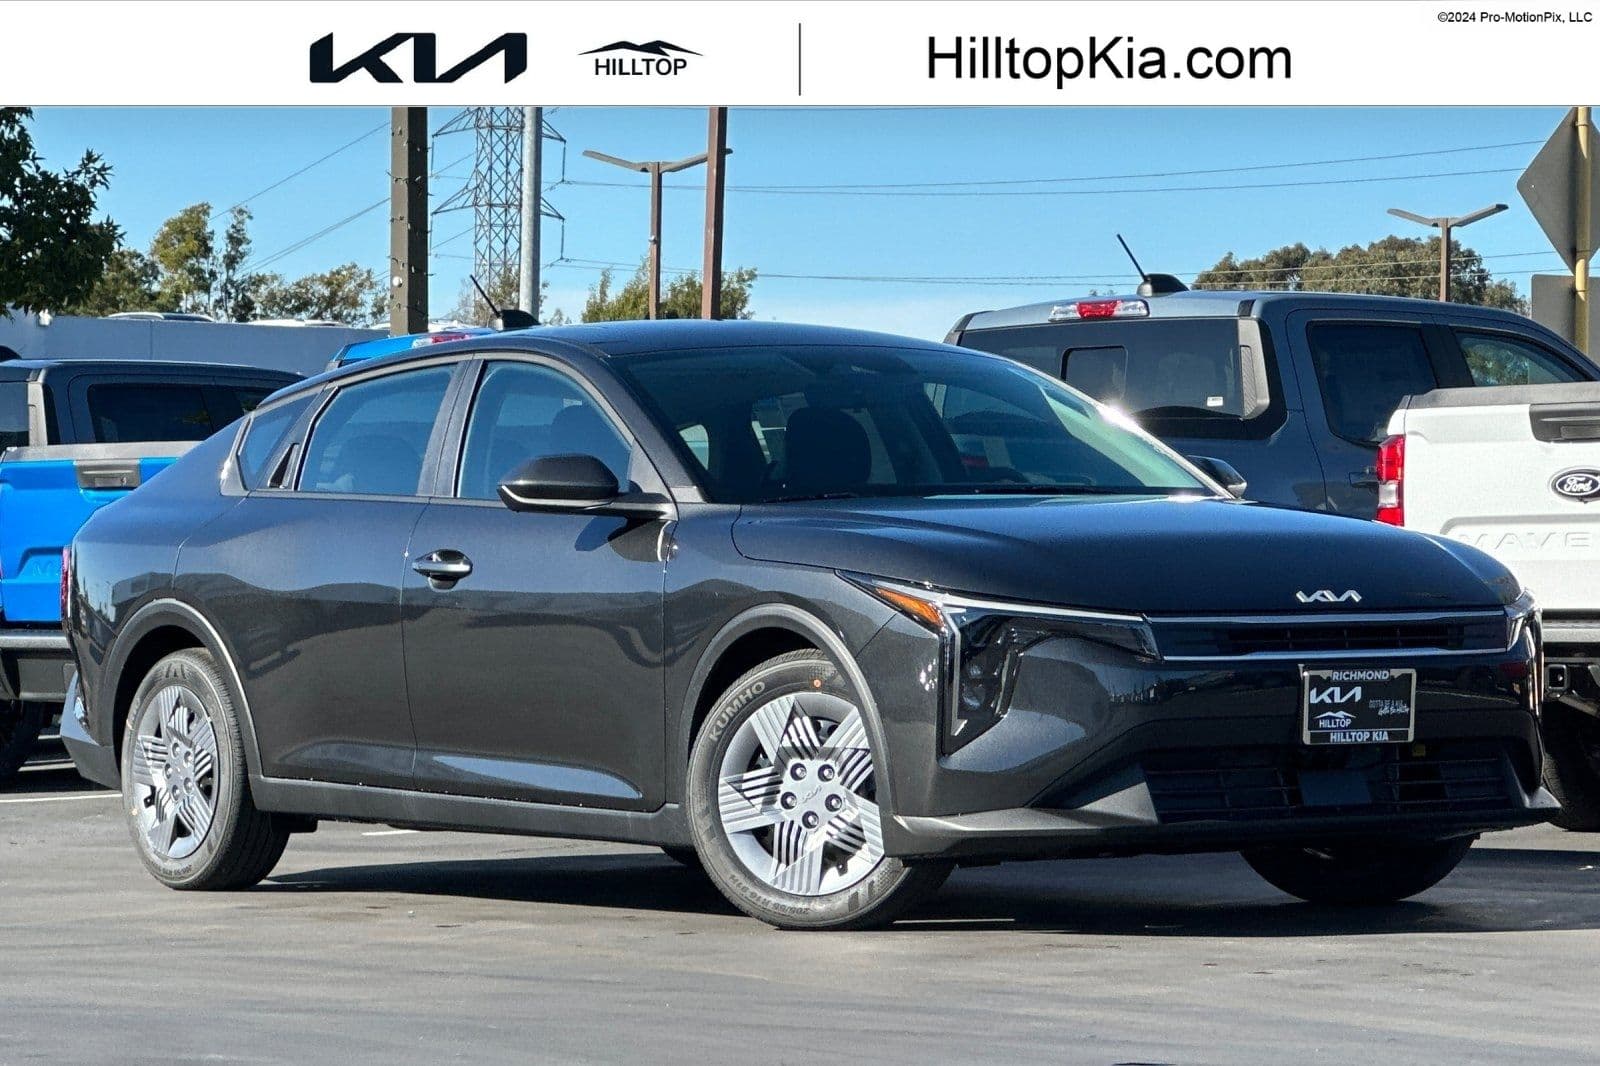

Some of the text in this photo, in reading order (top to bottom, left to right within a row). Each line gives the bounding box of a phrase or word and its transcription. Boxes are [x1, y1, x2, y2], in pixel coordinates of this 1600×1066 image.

[1332, 670, 1390, 681] RICHMOND
[709, 681, 766, 742] KUMHO
[1319, 718, 1352, 729] HILLTOP
[1330, 731, 1389, 743] HILLTOP KIA
